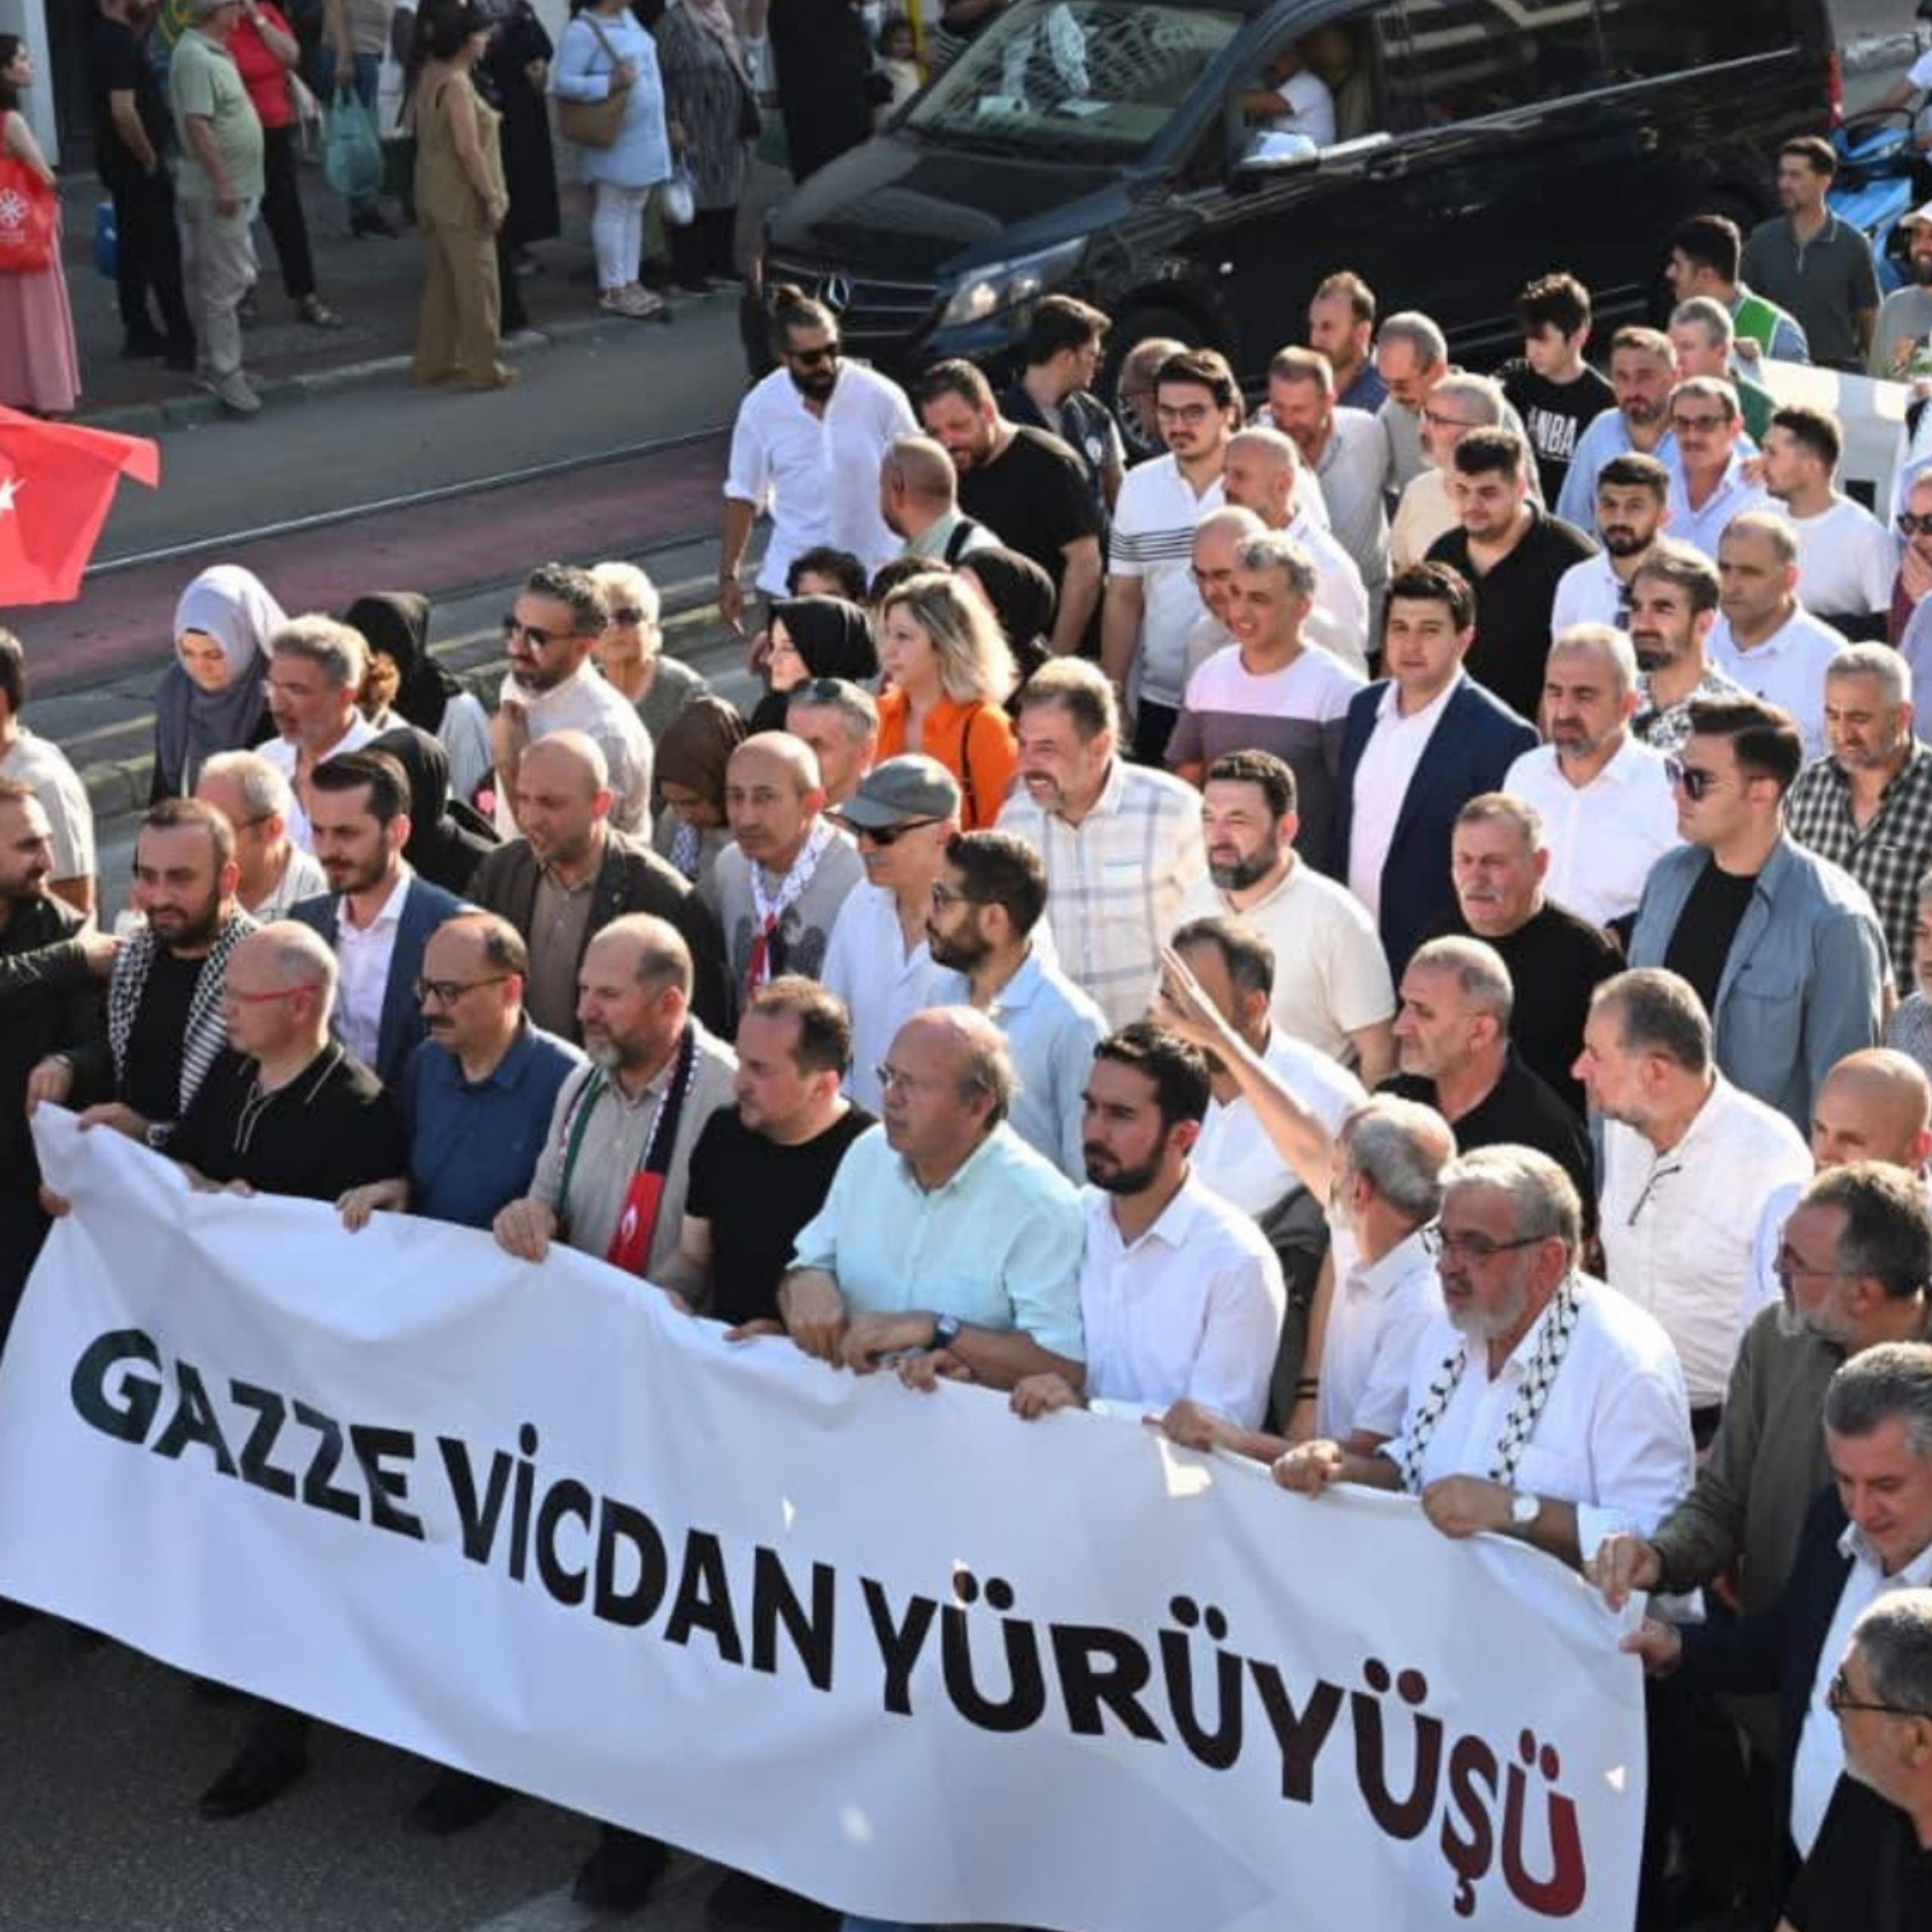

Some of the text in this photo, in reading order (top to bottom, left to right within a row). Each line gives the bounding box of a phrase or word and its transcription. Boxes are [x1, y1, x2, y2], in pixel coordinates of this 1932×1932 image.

[71, 1328, 1586, 1917] GAZZE VİCDAN YÜRÜYÜŞÜ
